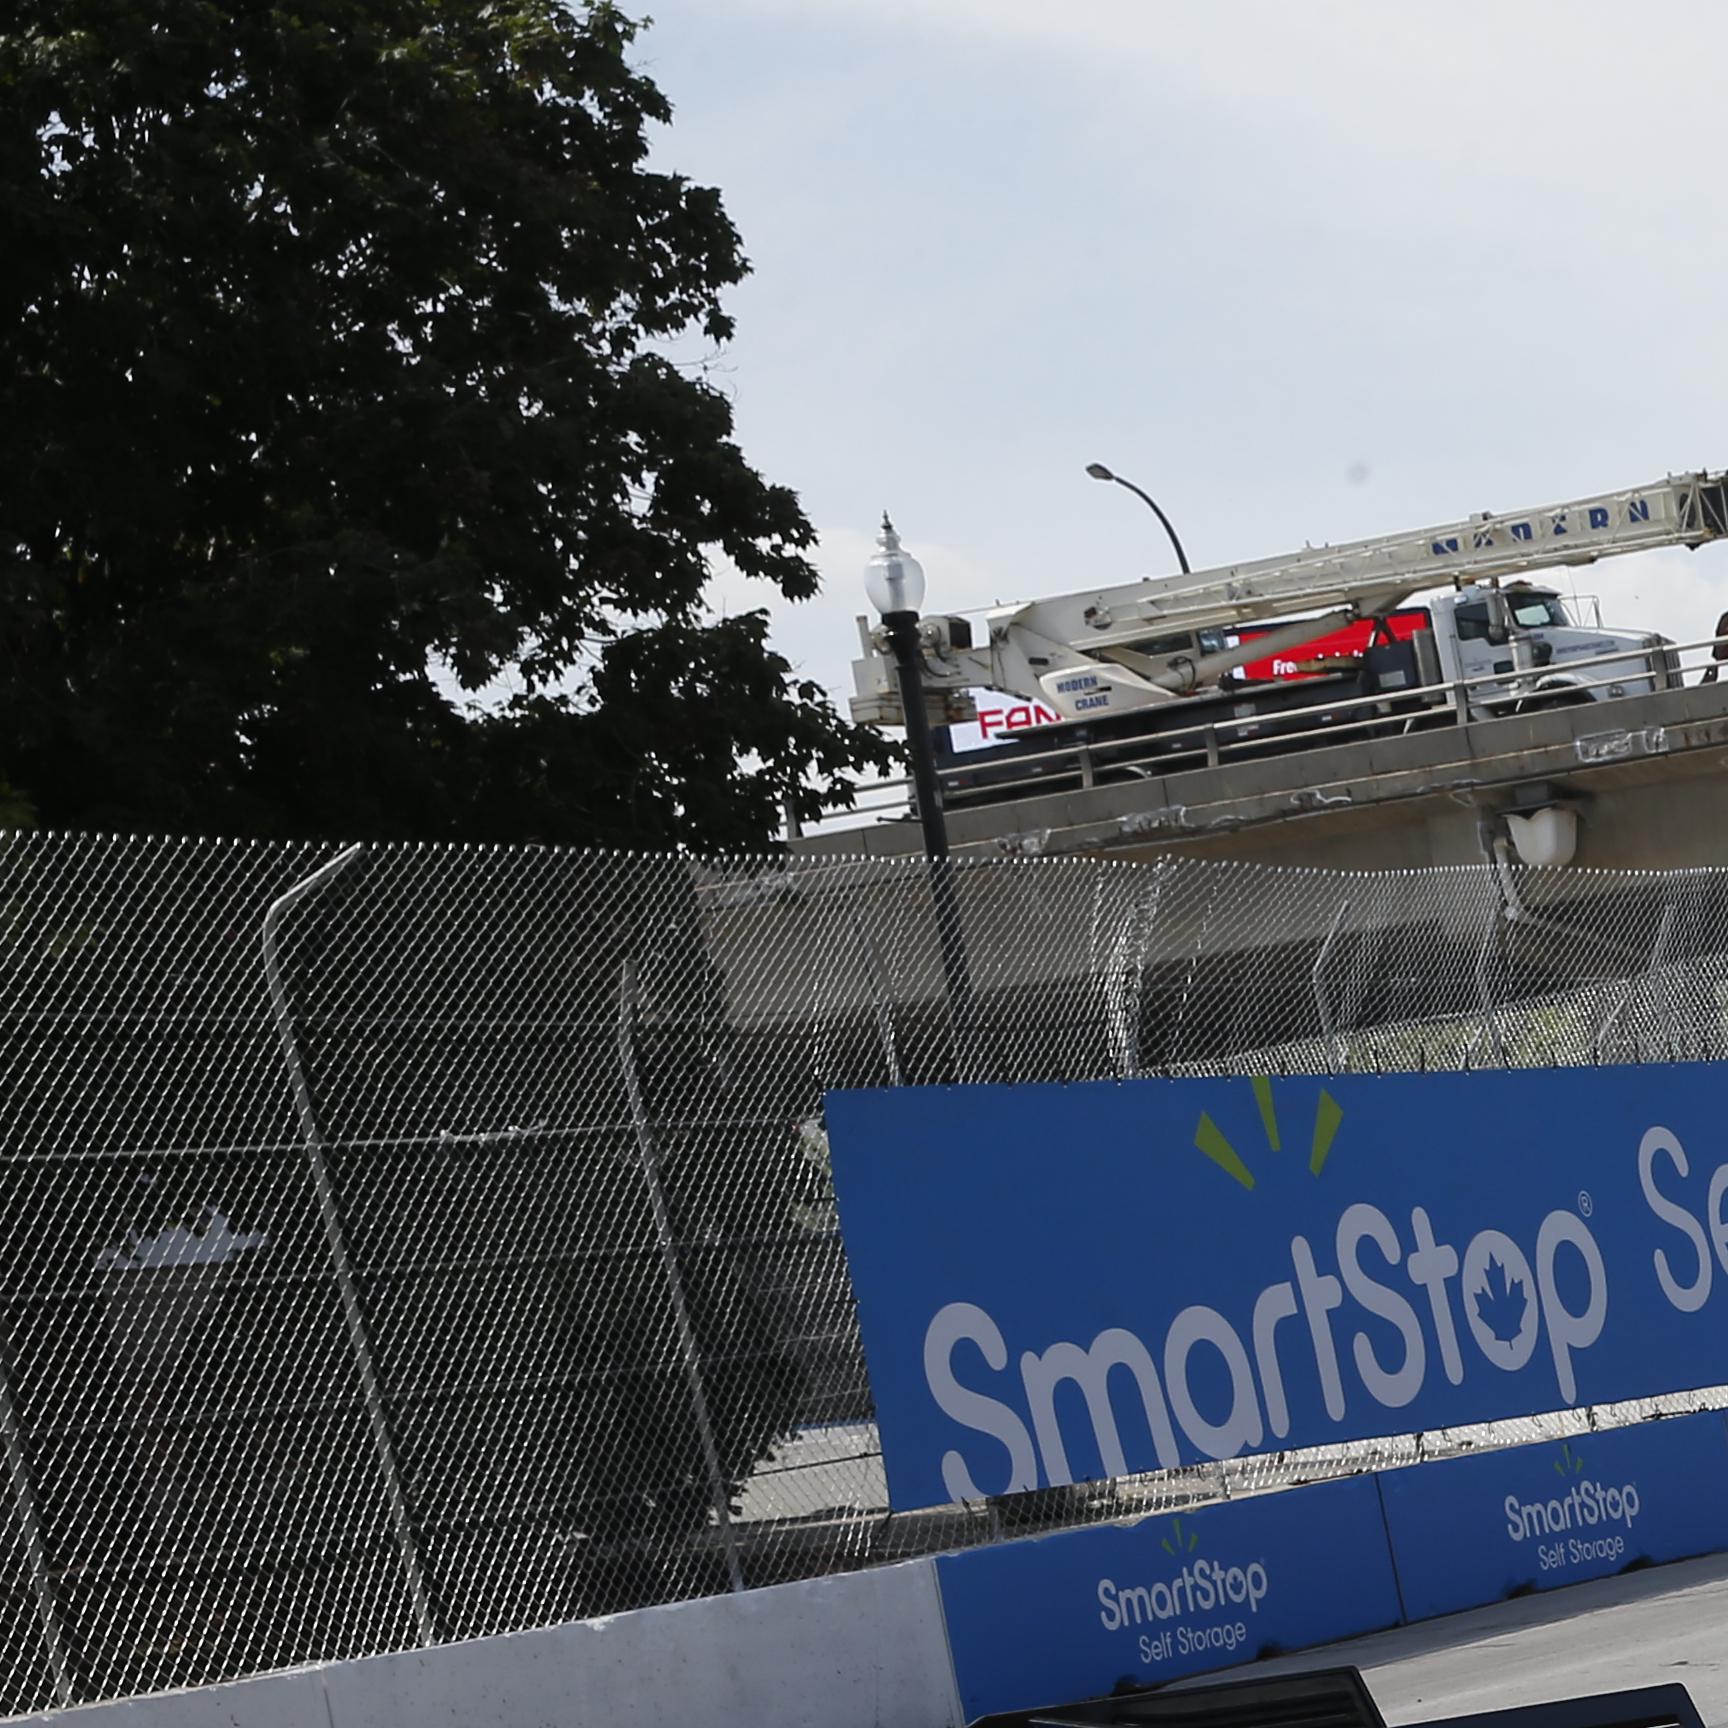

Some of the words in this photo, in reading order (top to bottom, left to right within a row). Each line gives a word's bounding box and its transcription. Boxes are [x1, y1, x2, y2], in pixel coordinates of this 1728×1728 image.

[1056, 675, 1098, 694] MODERN
[1074, 694, 1110, 712] CRANE
[1502, 1478, 1641, 1543] SmartStop
[1537, 1541, 1568, 1572] Self
[1569, 1533, 1625, 1563] Storage
[1097, 1558, 1269, 1631] SmartStop
[1138, 1632, 1175, 1664] Self
[1177, 1620, 1247, 1656] Storage
